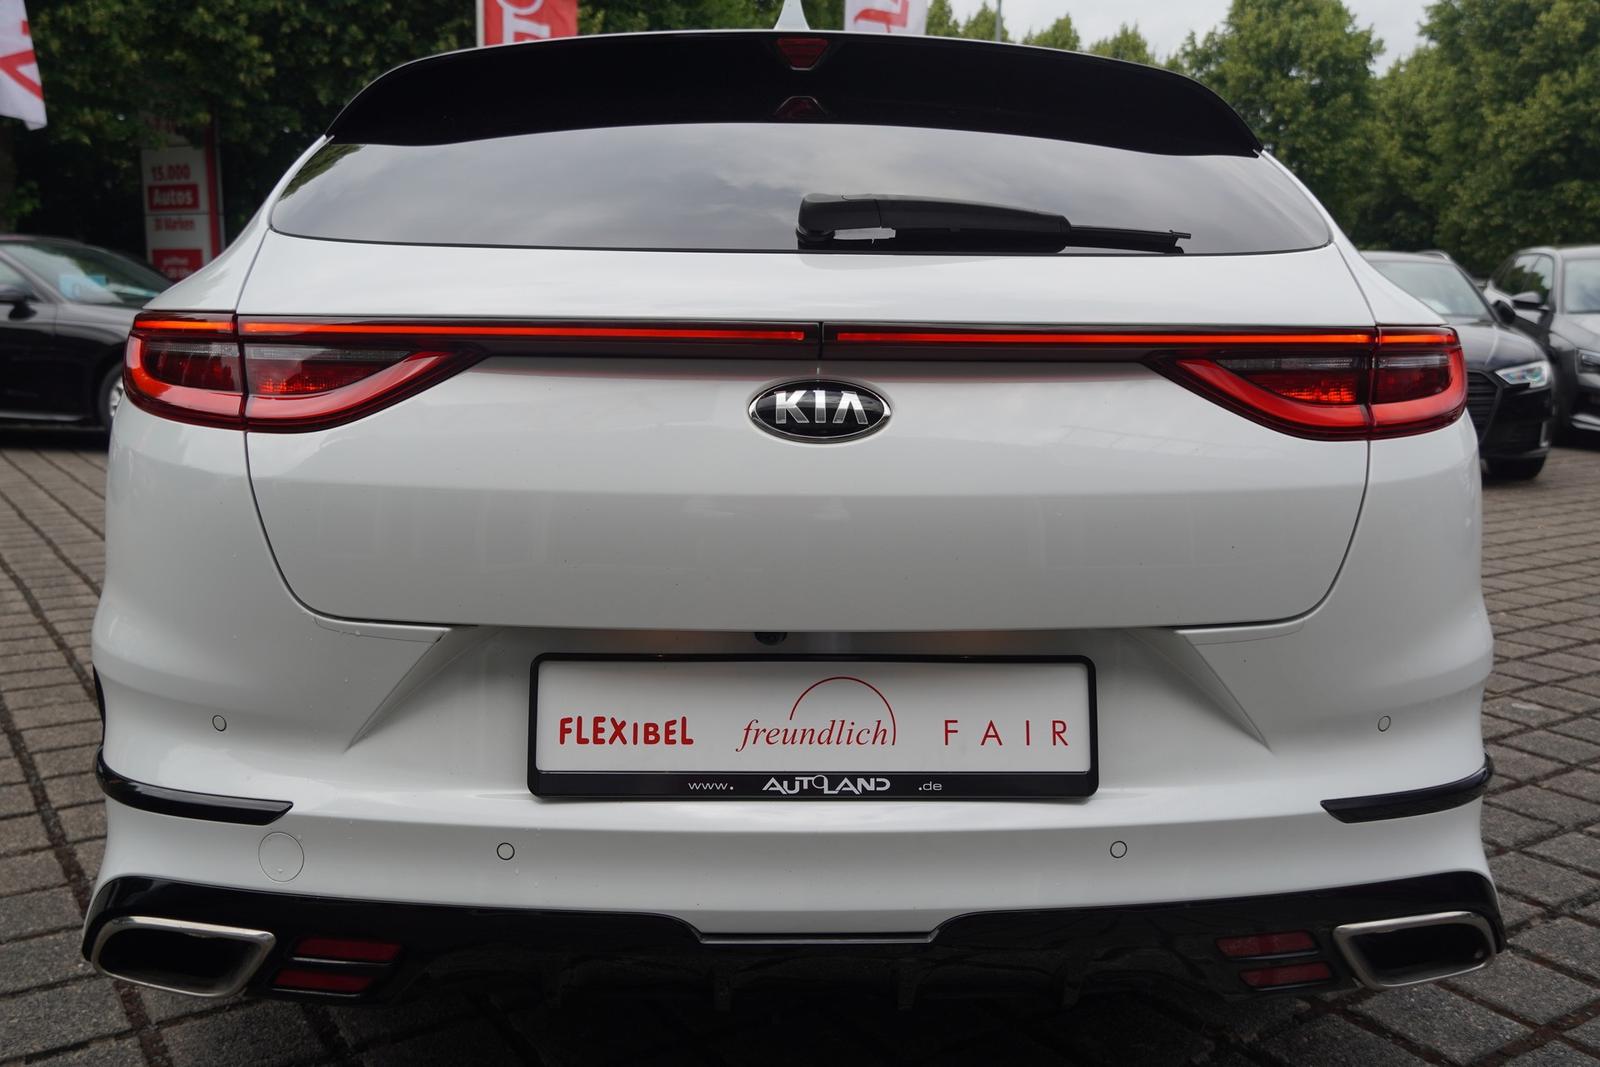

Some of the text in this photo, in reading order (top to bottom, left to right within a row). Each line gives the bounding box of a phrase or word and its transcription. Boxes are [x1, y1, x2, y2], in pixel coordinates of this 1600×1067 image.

[152, 189, 193, 206] Autos
[774, 390, 869, 424] KIA
[559, 716, 1069, 752] FLEXIBEL freundlich FAIR
[762, 774, 891, 795] AUTOLAND
